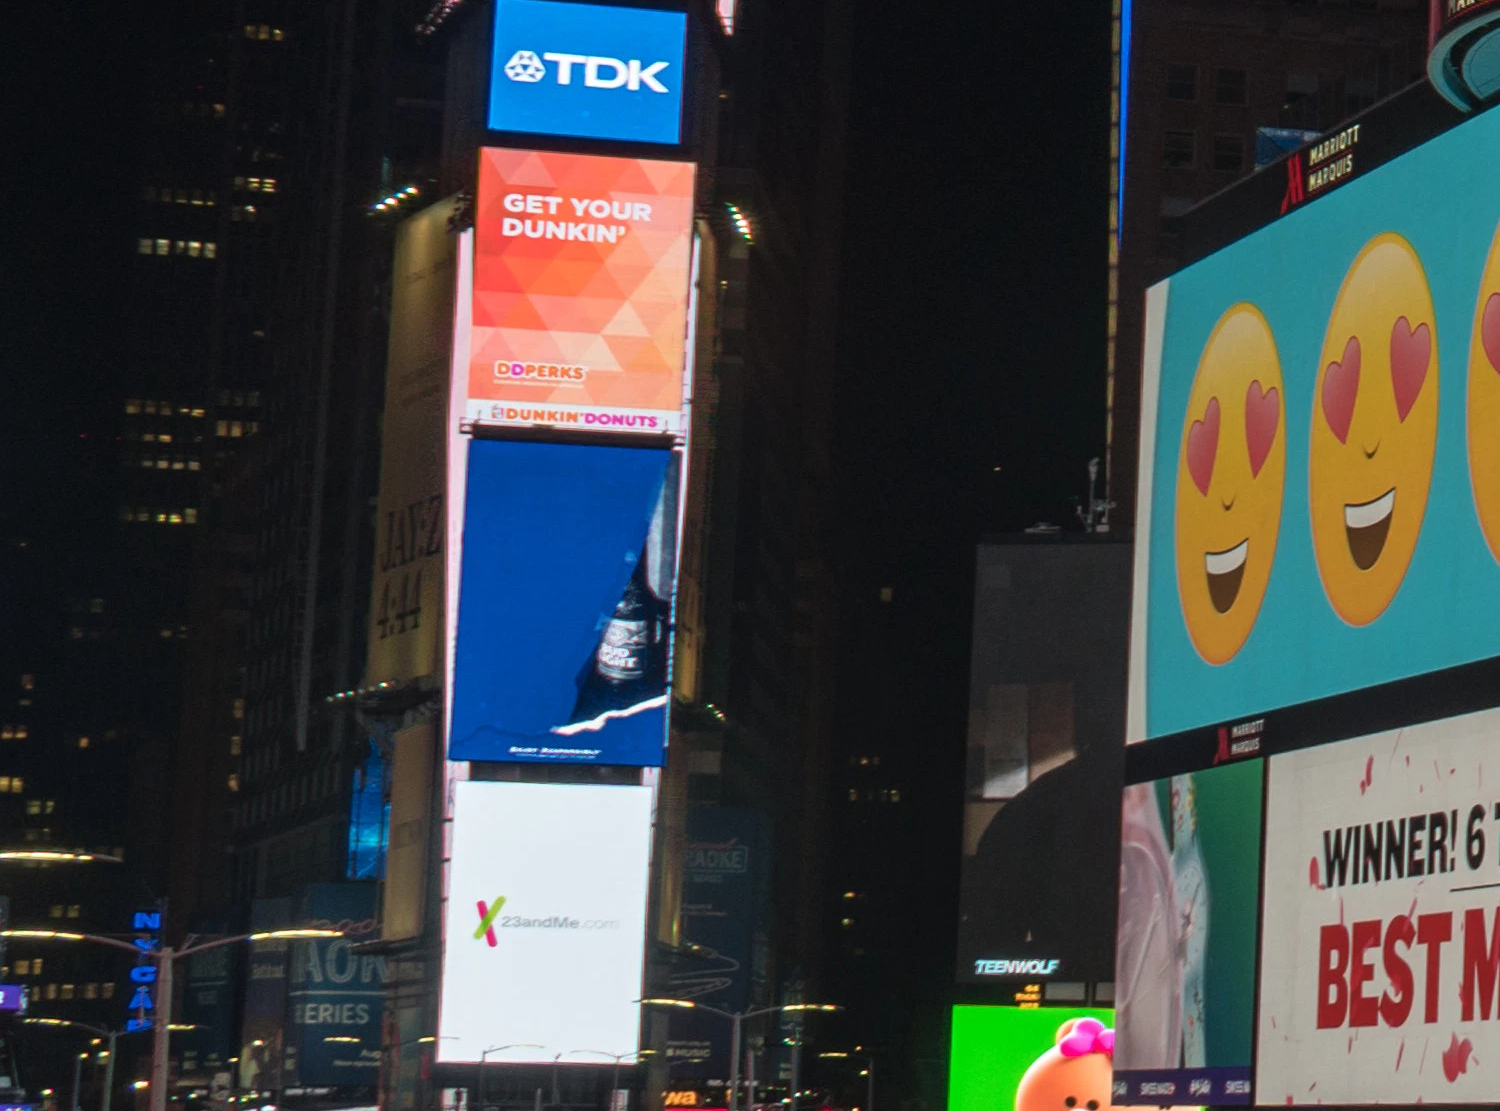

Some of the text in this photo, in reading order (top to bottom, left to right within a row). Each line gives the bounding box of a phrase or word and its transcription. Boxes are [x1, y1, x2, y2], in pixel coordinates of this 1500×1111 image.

[543, 51, 669, 94] TDK
[1309, 124, 1360, 166] MARRIOTT
[1308, 153, 1353, 192] MARQUIS
[503, 194, 652, 222] GET YOUR
[584, 412, 657, 429] DONUTS
[1322, 808, 1460, 889] WINNER!
[1467, 804, 1484, 869] 6
[501, 915, 619, 931] 23andMe.com
[1316, 911, 1453, 1030] BEST
